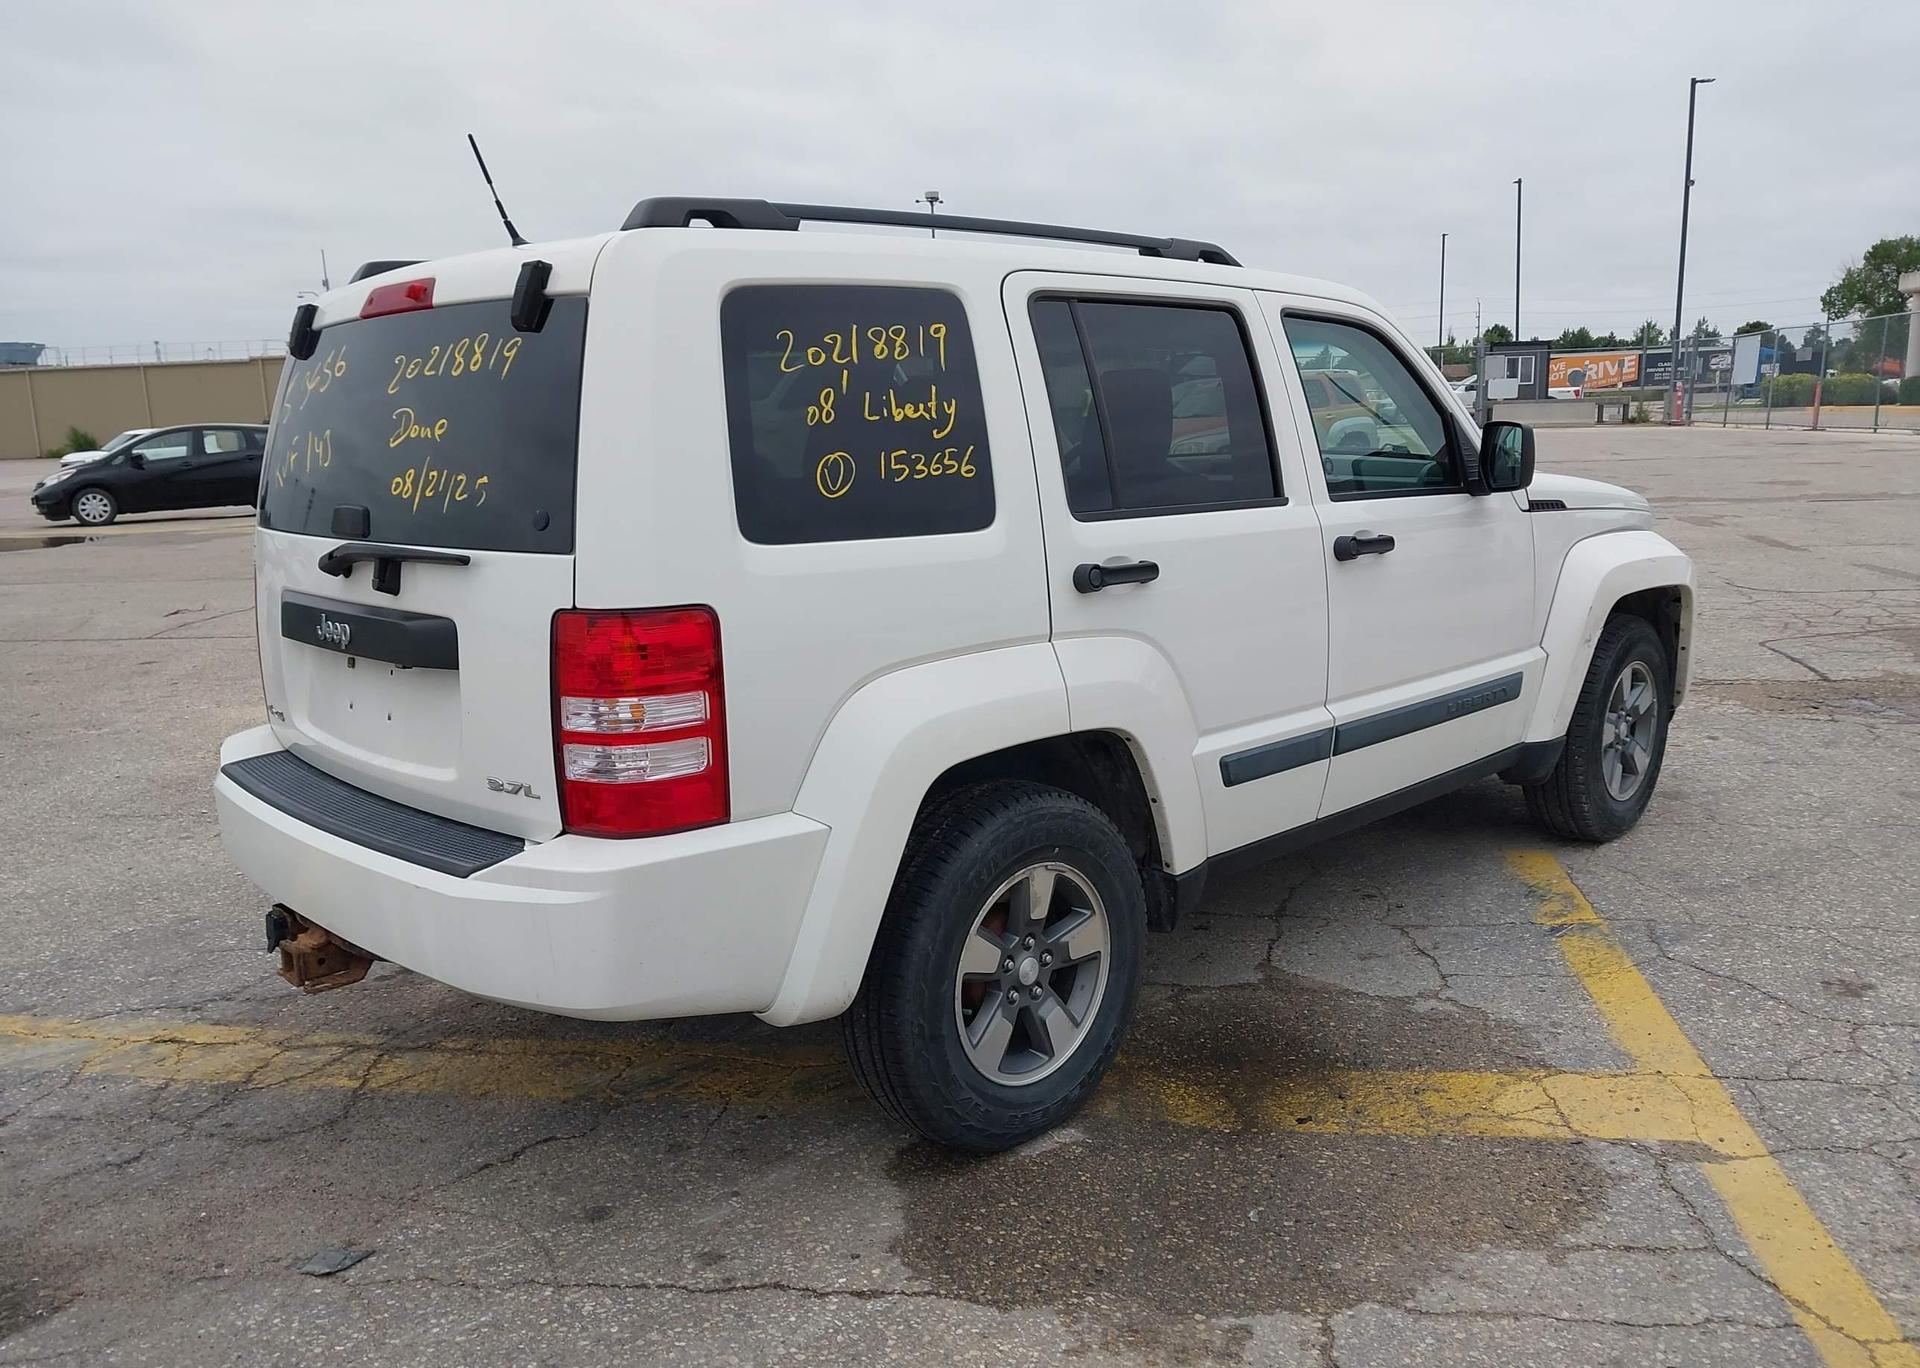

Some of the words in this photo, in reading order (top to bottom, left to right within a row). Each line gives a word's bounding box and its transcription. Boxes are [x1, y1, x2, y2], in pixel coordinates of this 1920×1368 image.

[387, 333, 522, 394] 20218819
[776, 323, 946, 373] 20218819
[389, 407, 448, 448] Done
[863, 385, 956, 439] Liberty
[879, 446, 976, 482] 153656
[316, 613, 350, 650] Jeep
